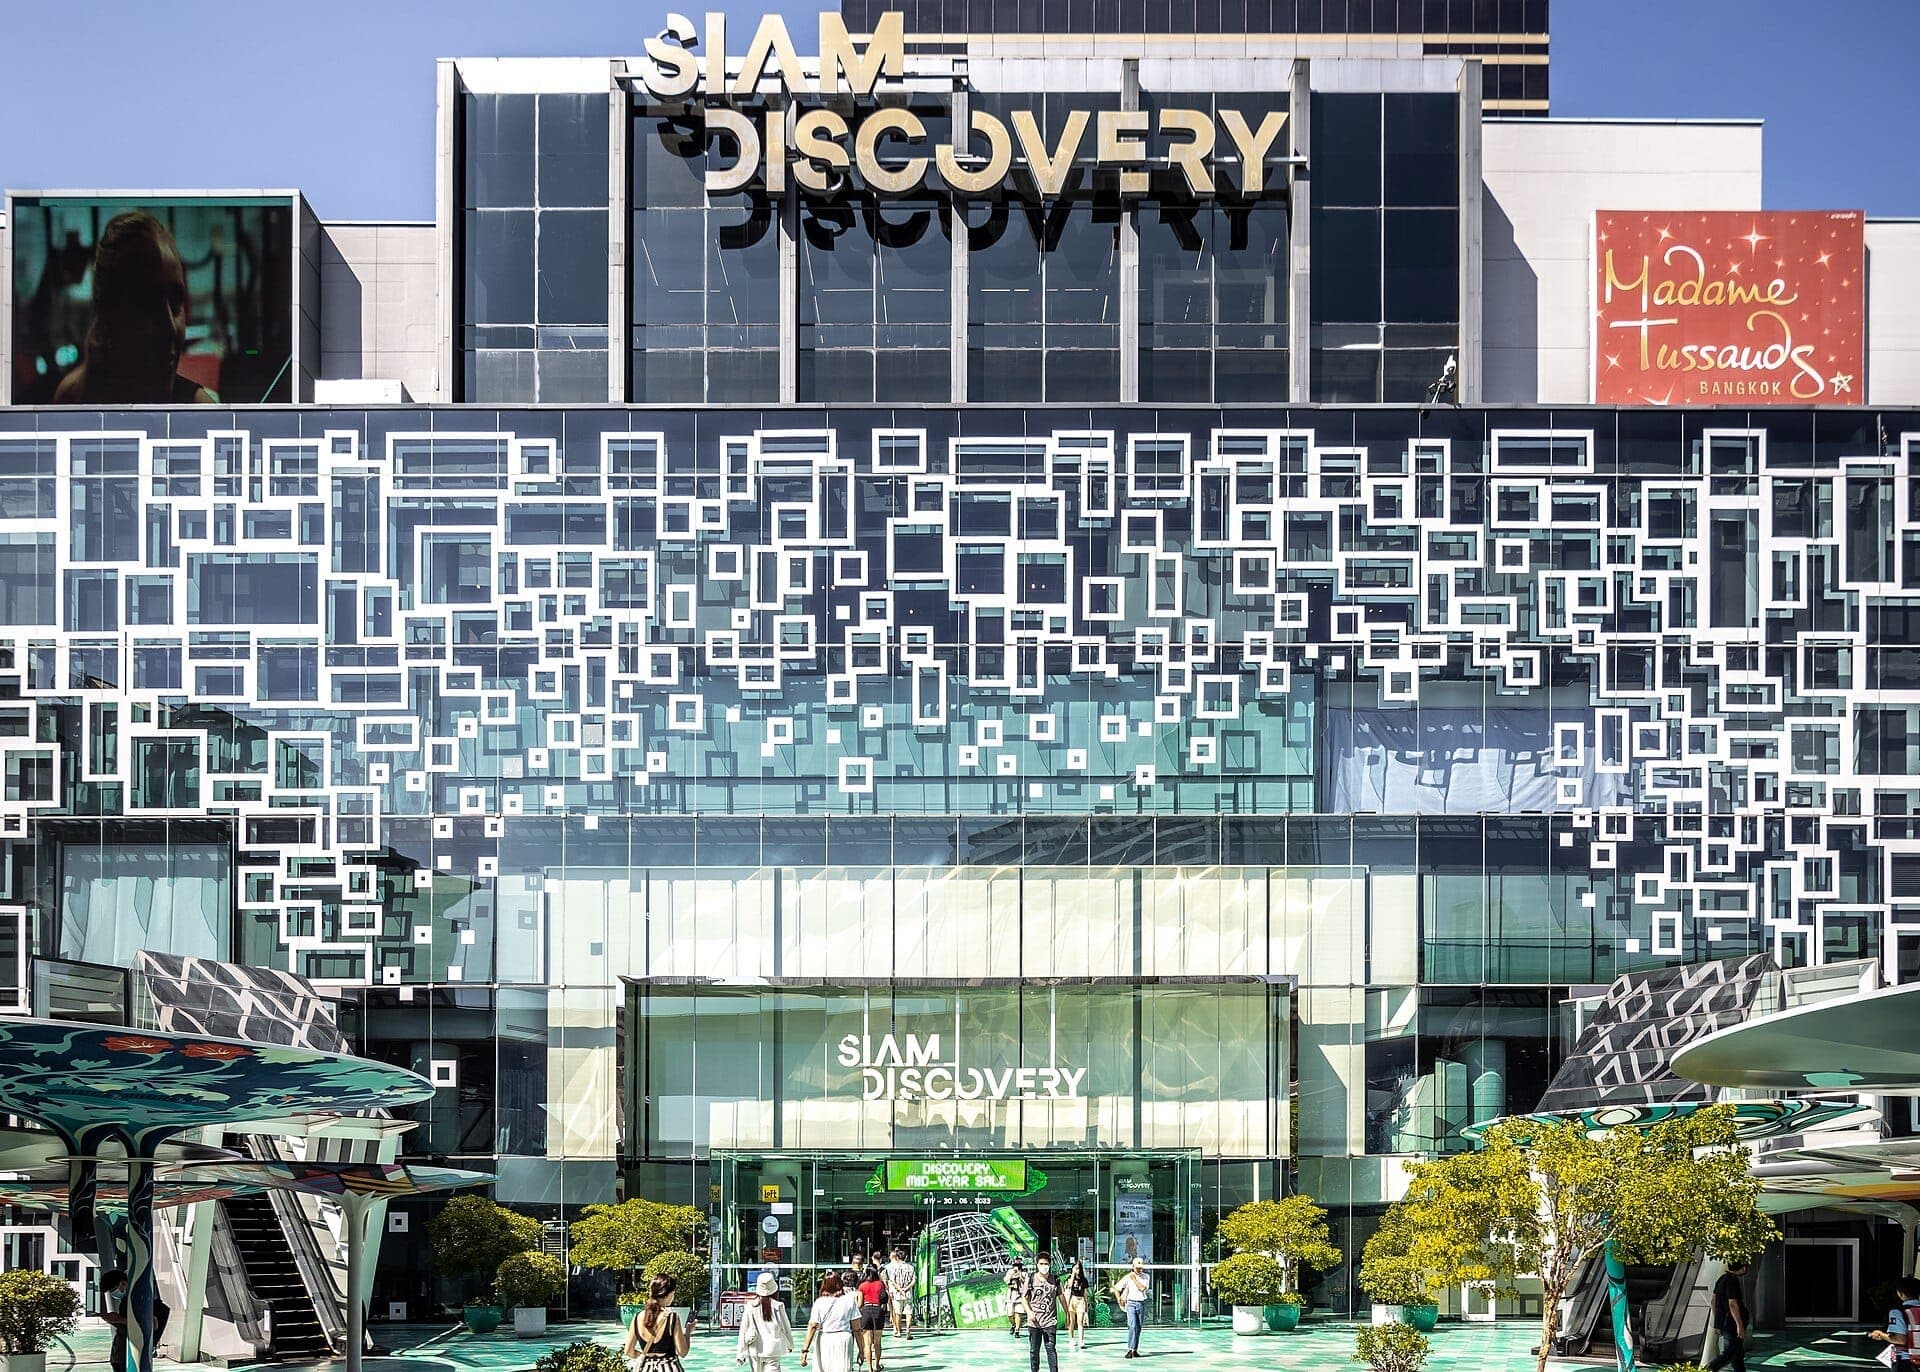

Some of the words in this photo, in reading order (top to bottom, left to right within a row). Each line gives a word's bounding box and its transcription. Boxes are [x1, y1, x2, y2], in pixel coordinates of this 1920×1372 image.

[639, 11, 905, 103] SIAM
[702, 107, 1289, 199] DISCOVERY
[1605, 244, 1798, 313] Madame
[1609, 309, 1825, 399] Tussauds
[1699, 381, 1781, 395] BANGKOK
[837, 1033, 940, 1067] SIAM
[863, 1067, 1088, 1100] DISCOVERY
[906, 1175, 970, 1187] MID-YEAR
[975, 1175, 1007, 1187] SALE
[922, 1163, 990, 1175] DISCOVERY
